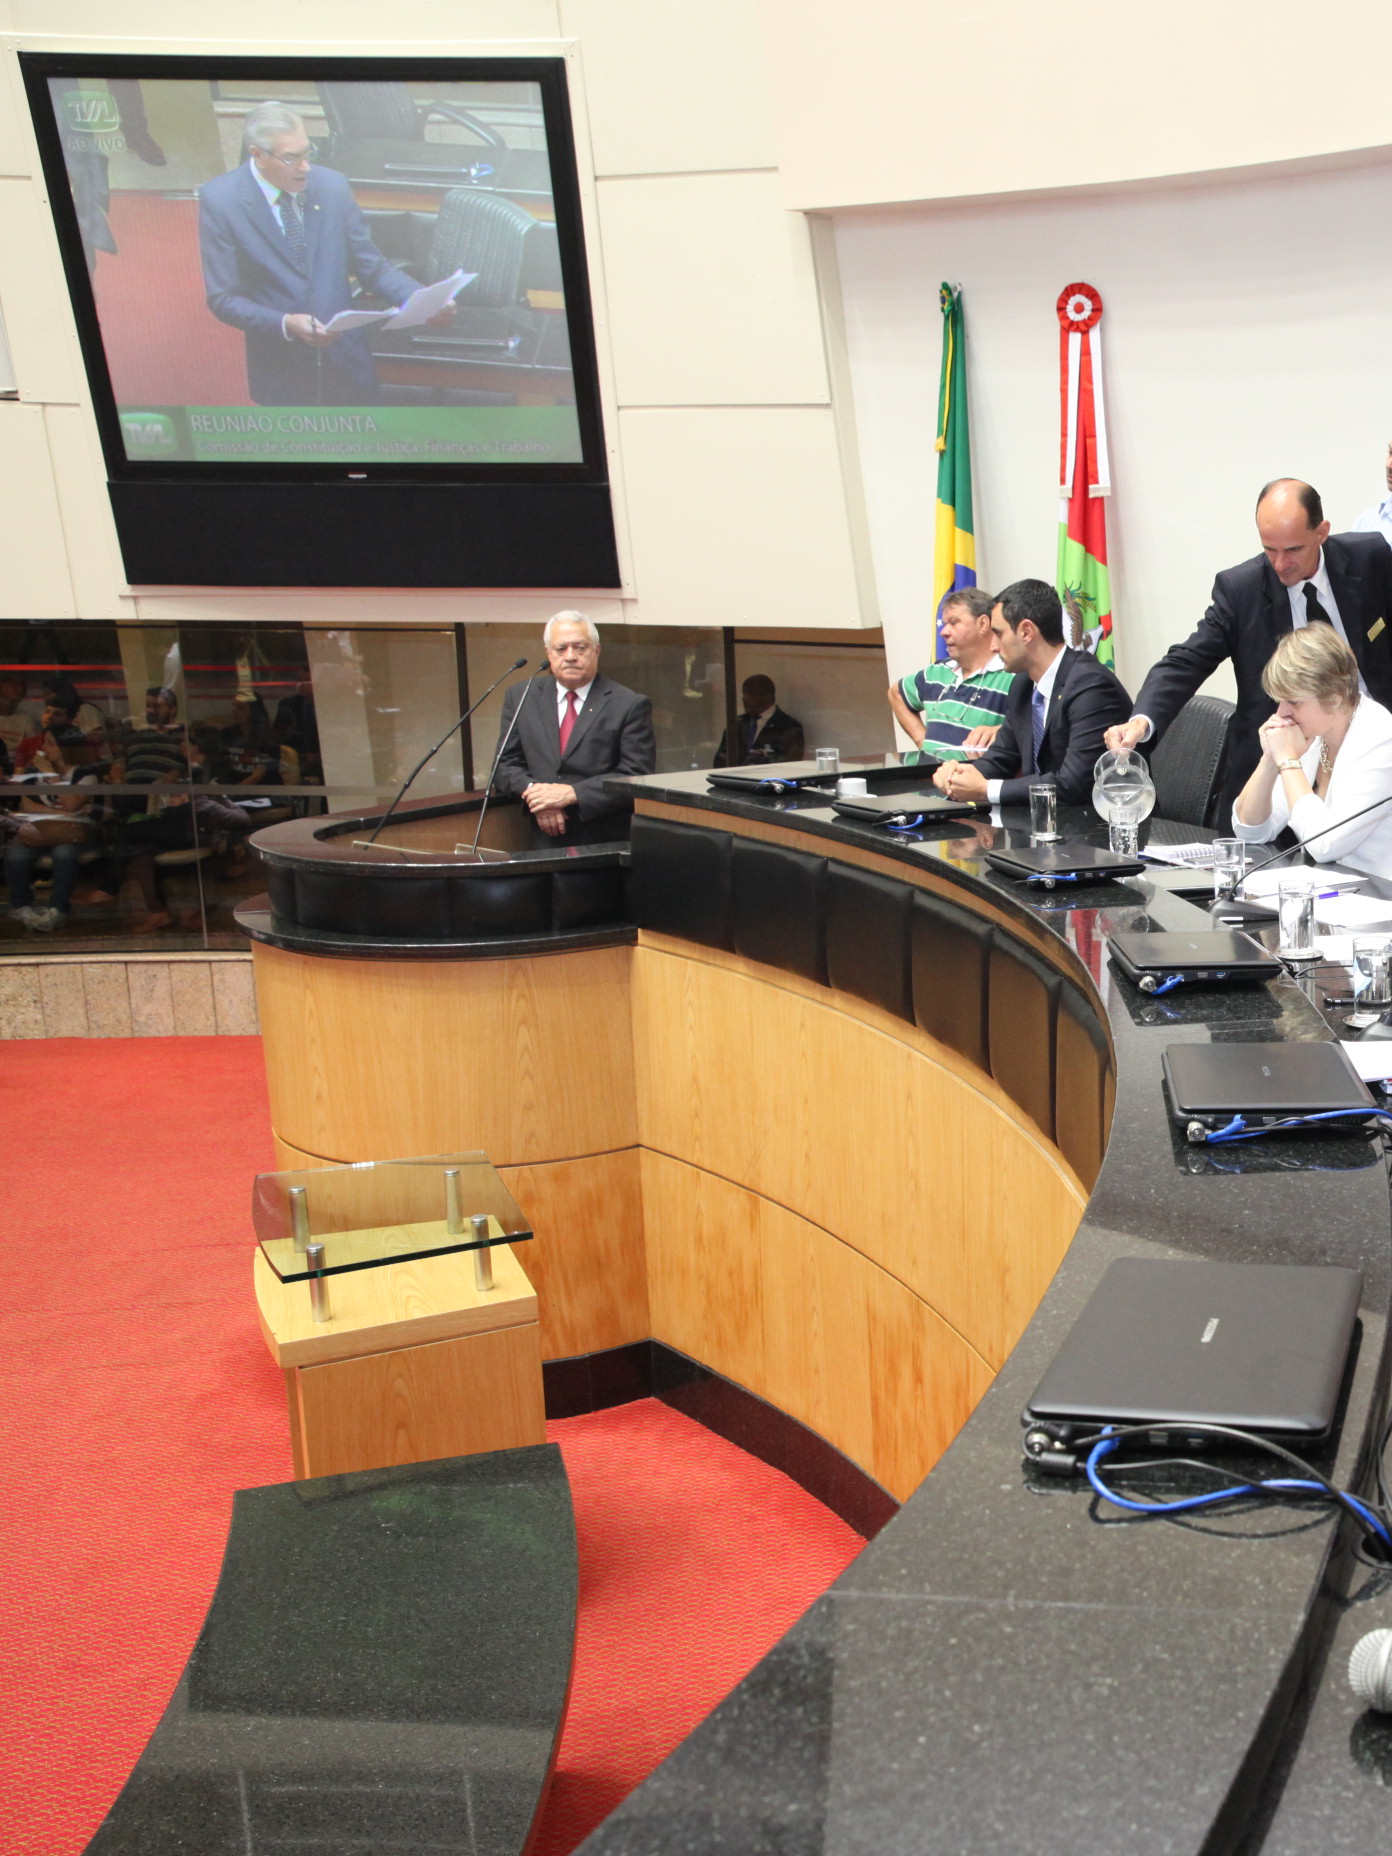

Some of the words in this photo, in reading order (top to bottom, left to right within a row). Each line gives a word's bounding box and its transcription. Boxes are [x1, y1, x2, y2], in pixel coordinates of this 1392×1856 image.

[70, 137, 88, 151] AO
[90, 137, 126, 152] VIVO
[276, 414, 378, 433] CONJUNTA
[262, 439, 280, 453] de
[493, 439, 552, 453] Trabalho
